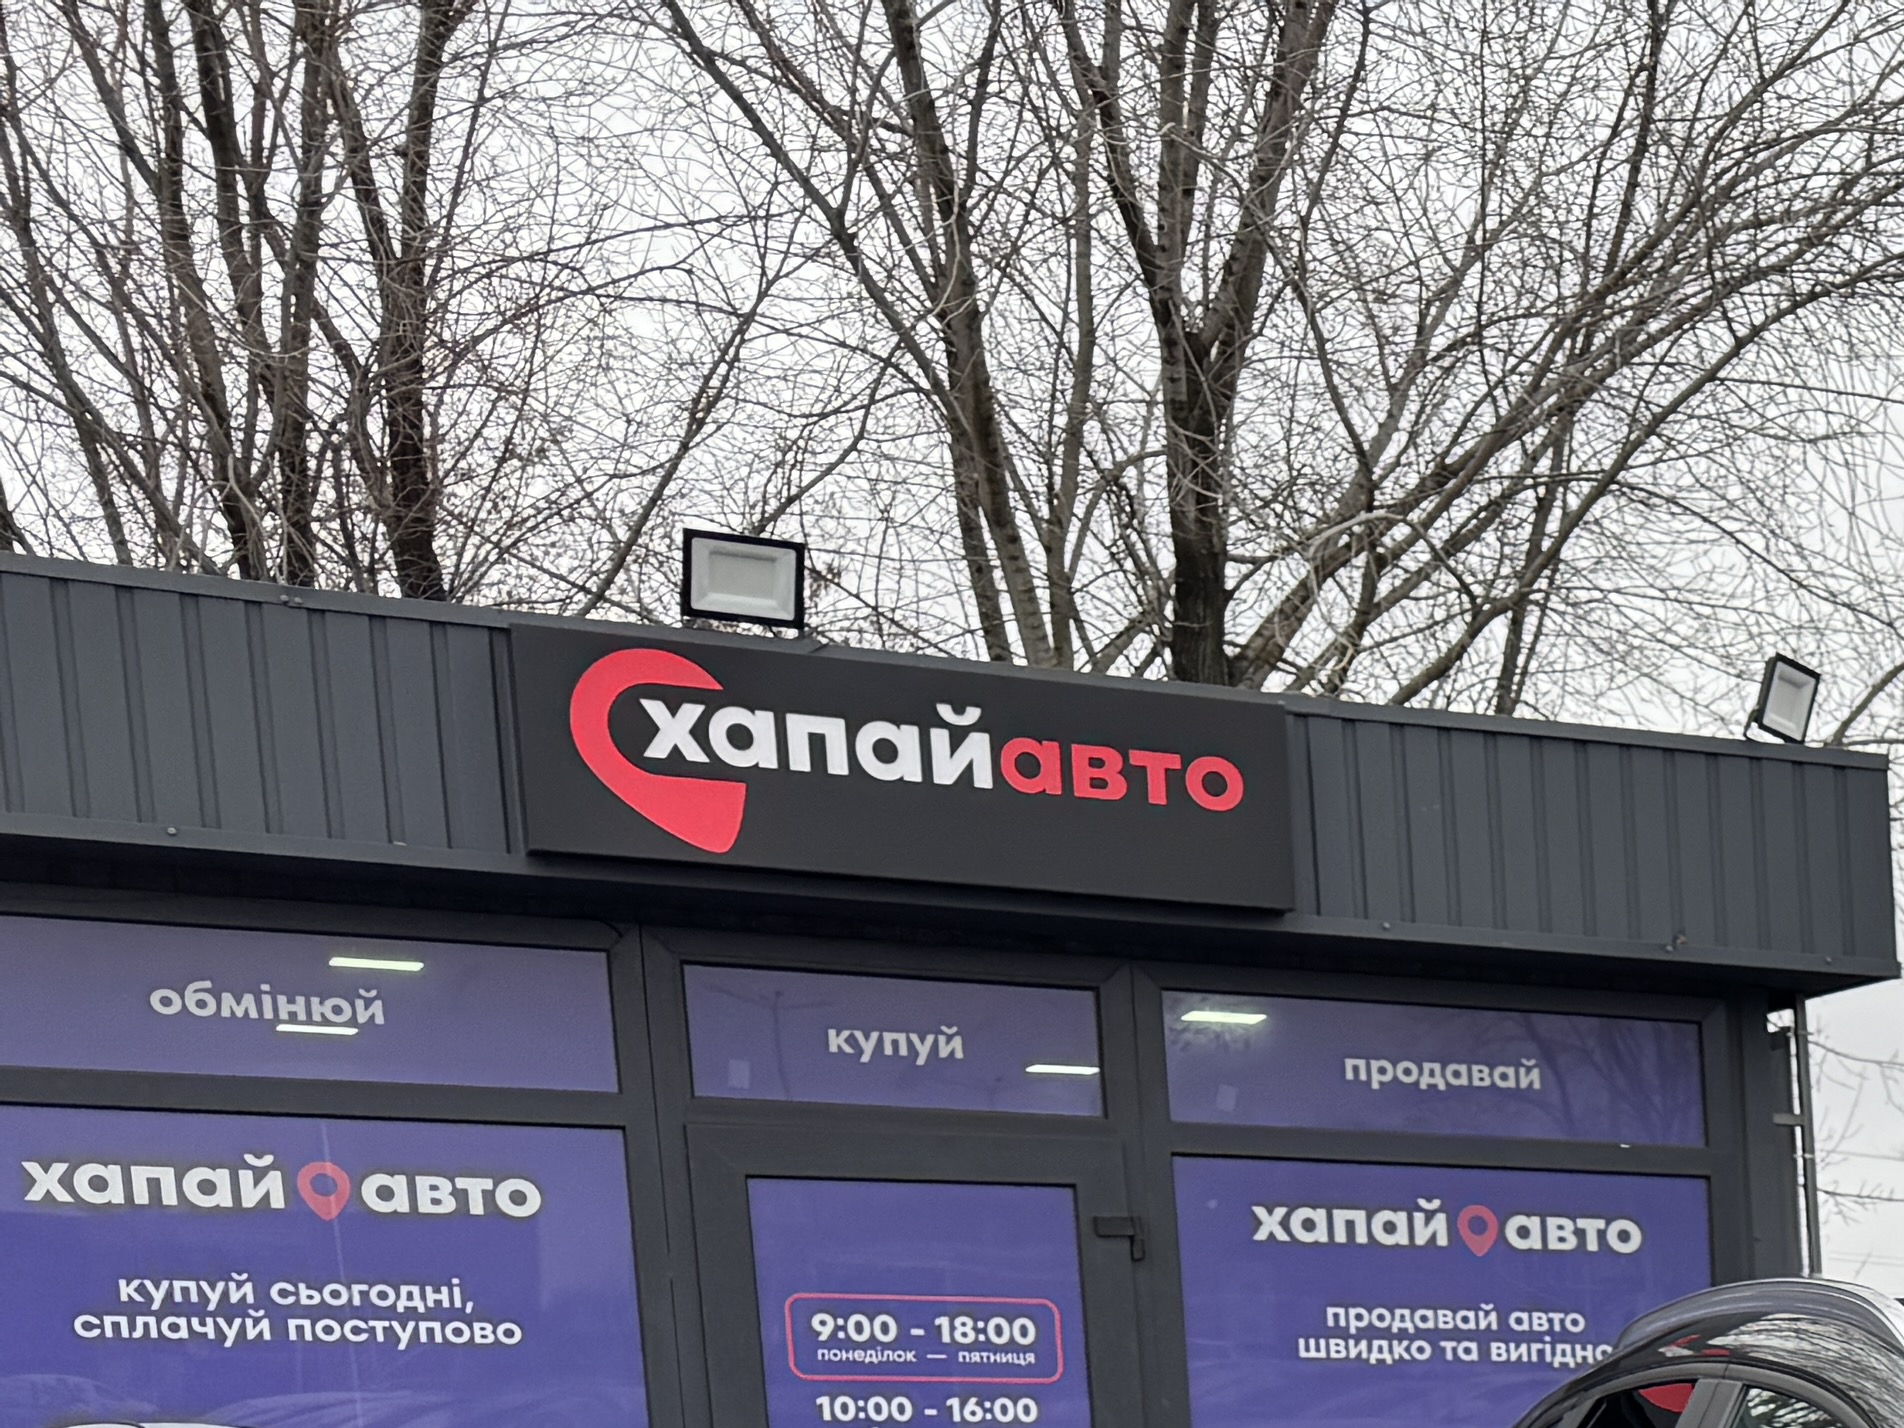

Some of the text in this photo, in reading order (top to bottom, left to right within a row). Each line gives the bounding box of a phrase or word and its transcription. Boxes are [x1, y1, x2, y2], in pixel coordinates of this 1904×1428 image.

[149, 977, 386, 1026] обмінюй
[826, 1021, 965, 1067] купуй
[1343, 1052, 1543, 1092] продавай
[22, 1152, 542, 1217] хапай авто
[1251, 1198, 1644, 1255] хапай авто
[118, 1273, 475, 1314] купуй сьогодні,
[73, 1308, 523, 1351] сплачуй поступово
[810, 1312, 898, 1344] 9:00
[934, 1315, 1037, 1346] 18:00
[1325, 1303, 1586, 1334] продавай авто
[817, 1346, 918, 1366] понеділок
[957, 1349, 1036, 1367] пятниця
[1298, 1337, 1433, 1366] швидко
[1441, 1340, 1479, 1363] та
[815, 1395, 913, 1423] 10:00
[945, 1396, 1039, 1424] 16:00
